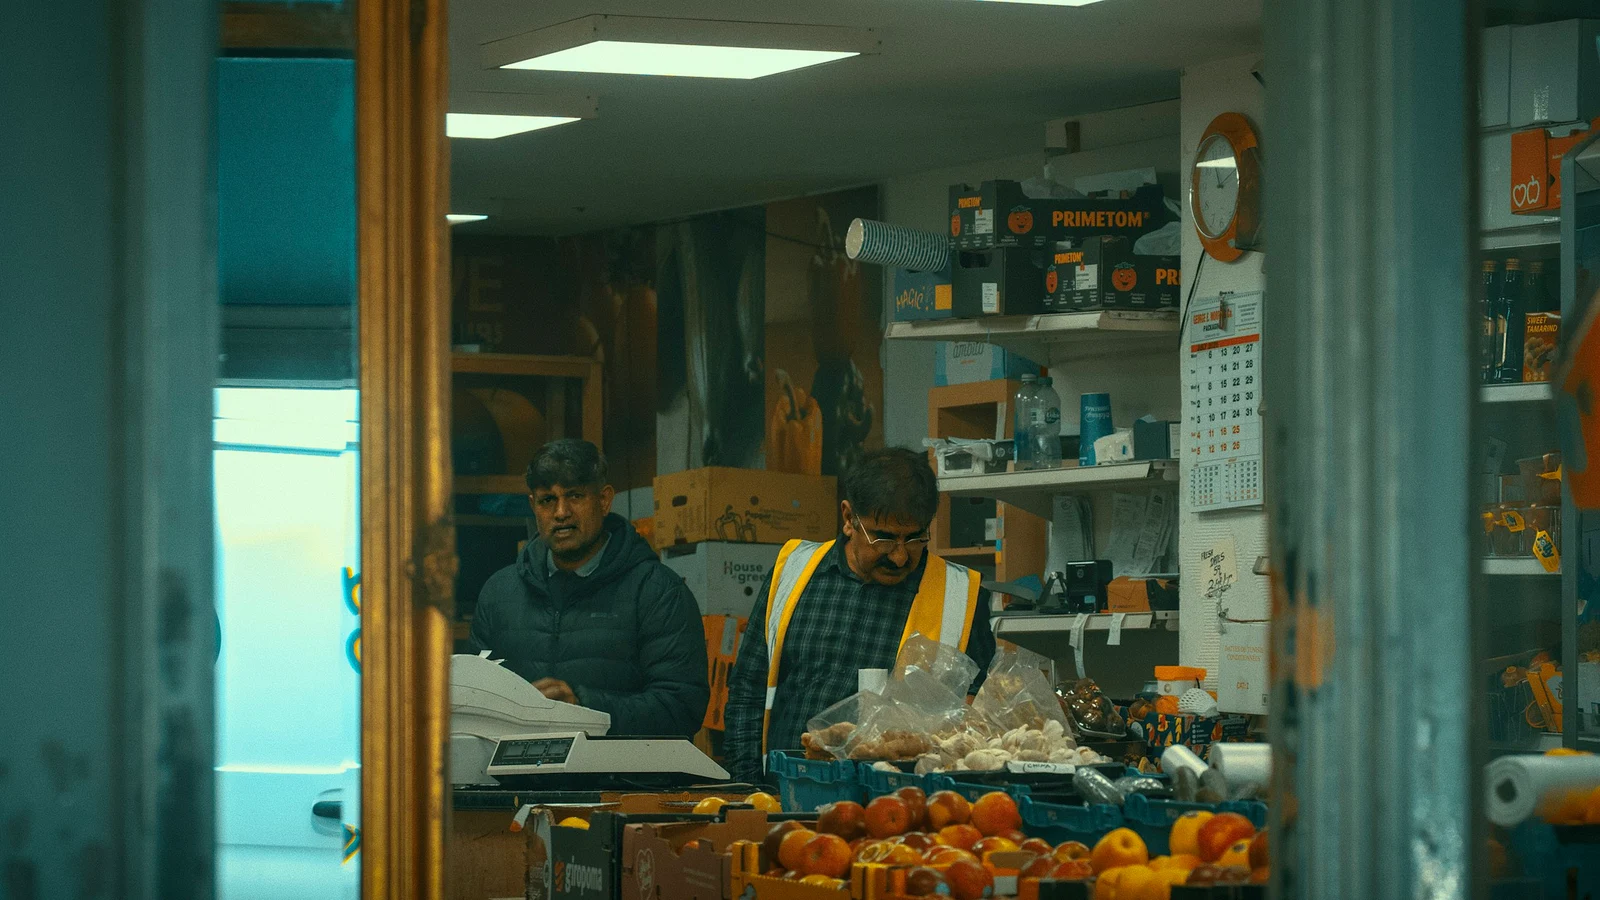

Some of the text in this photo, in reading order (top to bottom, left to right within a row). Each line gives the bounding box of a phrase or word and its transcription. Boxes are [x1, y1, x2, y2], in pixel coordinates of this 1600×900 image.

[1054, 252, 1082, 264] PRIMETOM
[1526, 316, 1548, 324] SWEET
[1526, 324, 1558, 333] TAMARIND
[1208, 350, 1212, 358] 6
[1221, 348, 1227, 356] 13
[1233, 346, 1240, 354] 20
[1245, 344, 1253, 352] 27
[1208, 366, 1212, 374] 7
[1221, 364, 1227, 372] 14
[1233, 361, 1239, 370] 21
[1245, 359, 1253, 368] 28
[1208, 382, 1212, 390] 8
[1221, 380, 1227, 388] 15
[1233, 378, 1240, 386] 22
[1245, 376, 1253, 384] 29
[1197, 400, 1200, 408] 2
[1208, 398, 1212, 406] 9
[1220, 396, 1227, 404] 16
[1232, 394, 1240, 402] 23
[1246, 392, 1253, 400] 30
[1197, 416, 1200, 424] 3
[1209, 413, 1215, 422] 10
[1220, 411, 1226, 420] 17
[1232, 410, 1240, 418] 24
[1246, 408, 1252, 416] 31
[1197, 431, 1200, 439] 4
[1209, 429, 1214, 437] 11
[1220, 427, 1227, 436] 18
[1232, 425, 1240, 434] 25
[1197, 447, 1200, 455] 5
[1209, 445, 1215, 453] 12
[1220, 443, 1227, 451] 19
[1232, 441, 1240, 450] 26
[724, 560, 763, 575] House
[565, 856, 603, 896] giropoma
